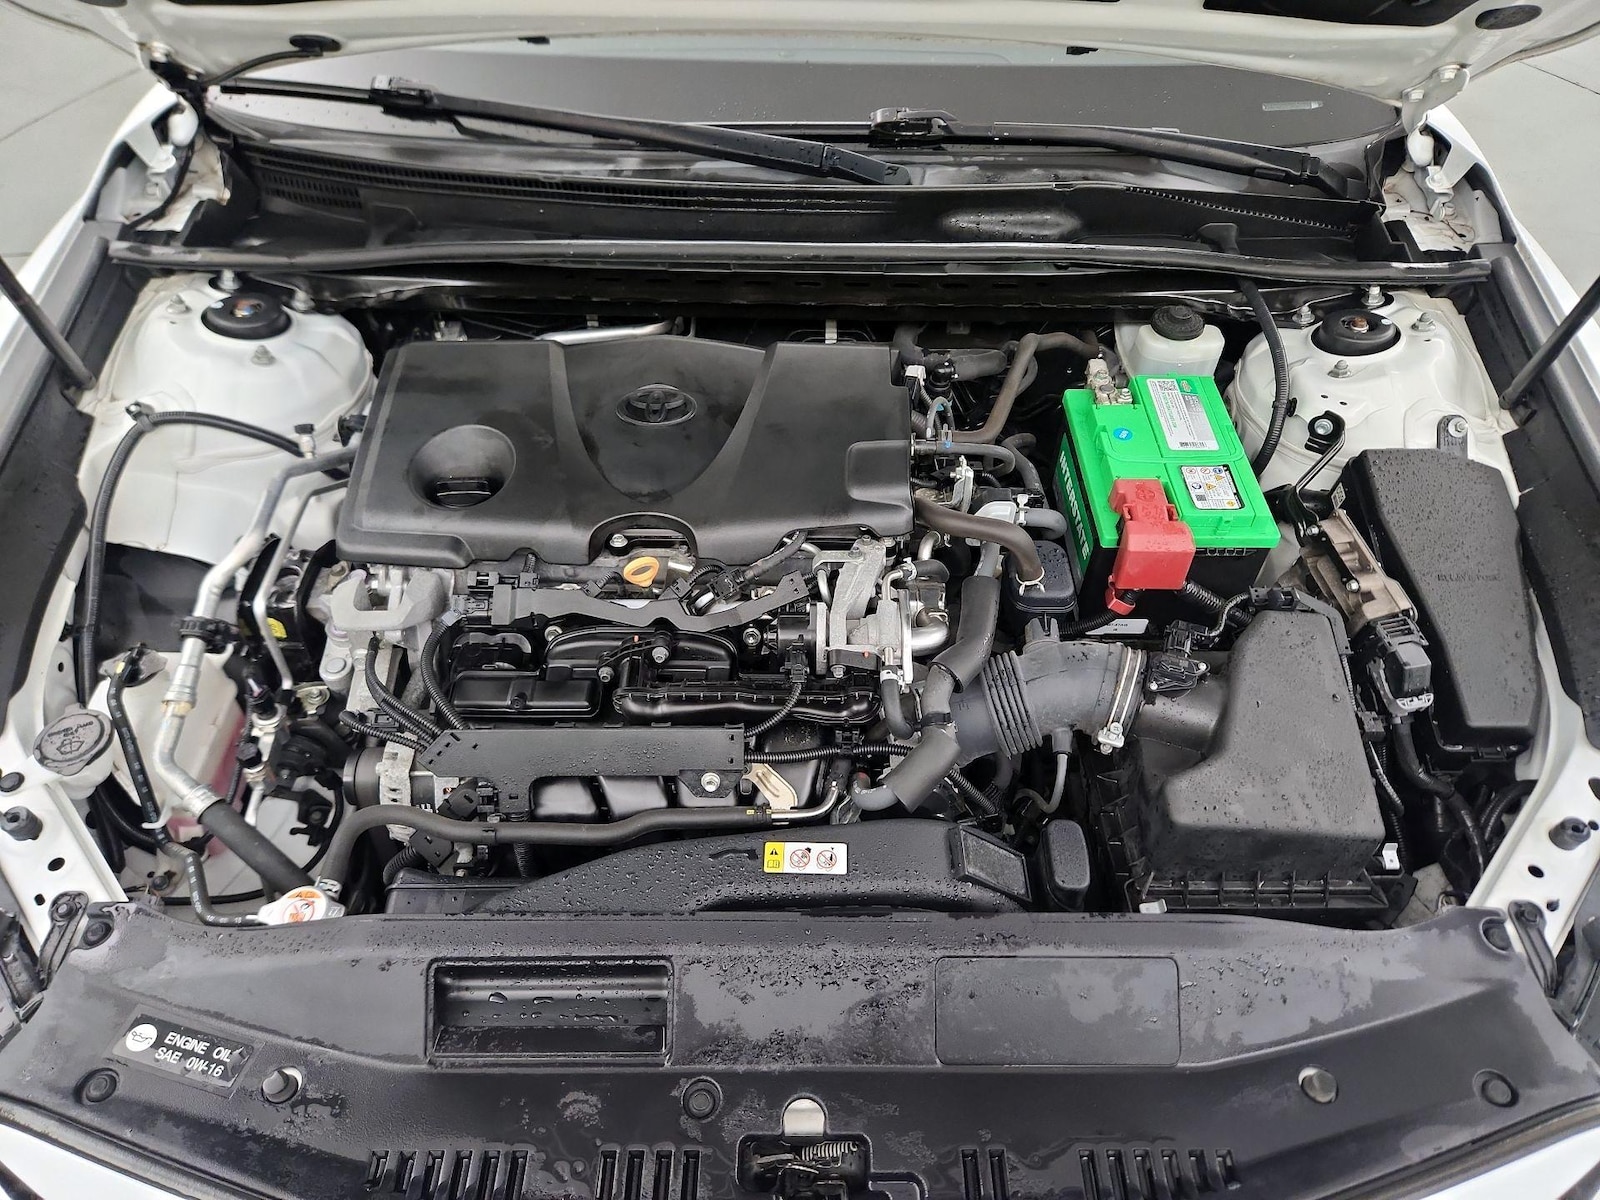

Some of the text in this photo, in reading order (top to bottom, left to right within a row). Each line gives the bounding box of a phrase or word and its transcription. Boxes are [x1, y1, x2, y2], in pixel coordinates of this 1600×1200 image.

[1060, 450, 1090, 560] INTERSTATE
[155, 1047, 225, 1077] SAE 0W-16
[164, 1031, 231, 1062] ENGINE OIL
